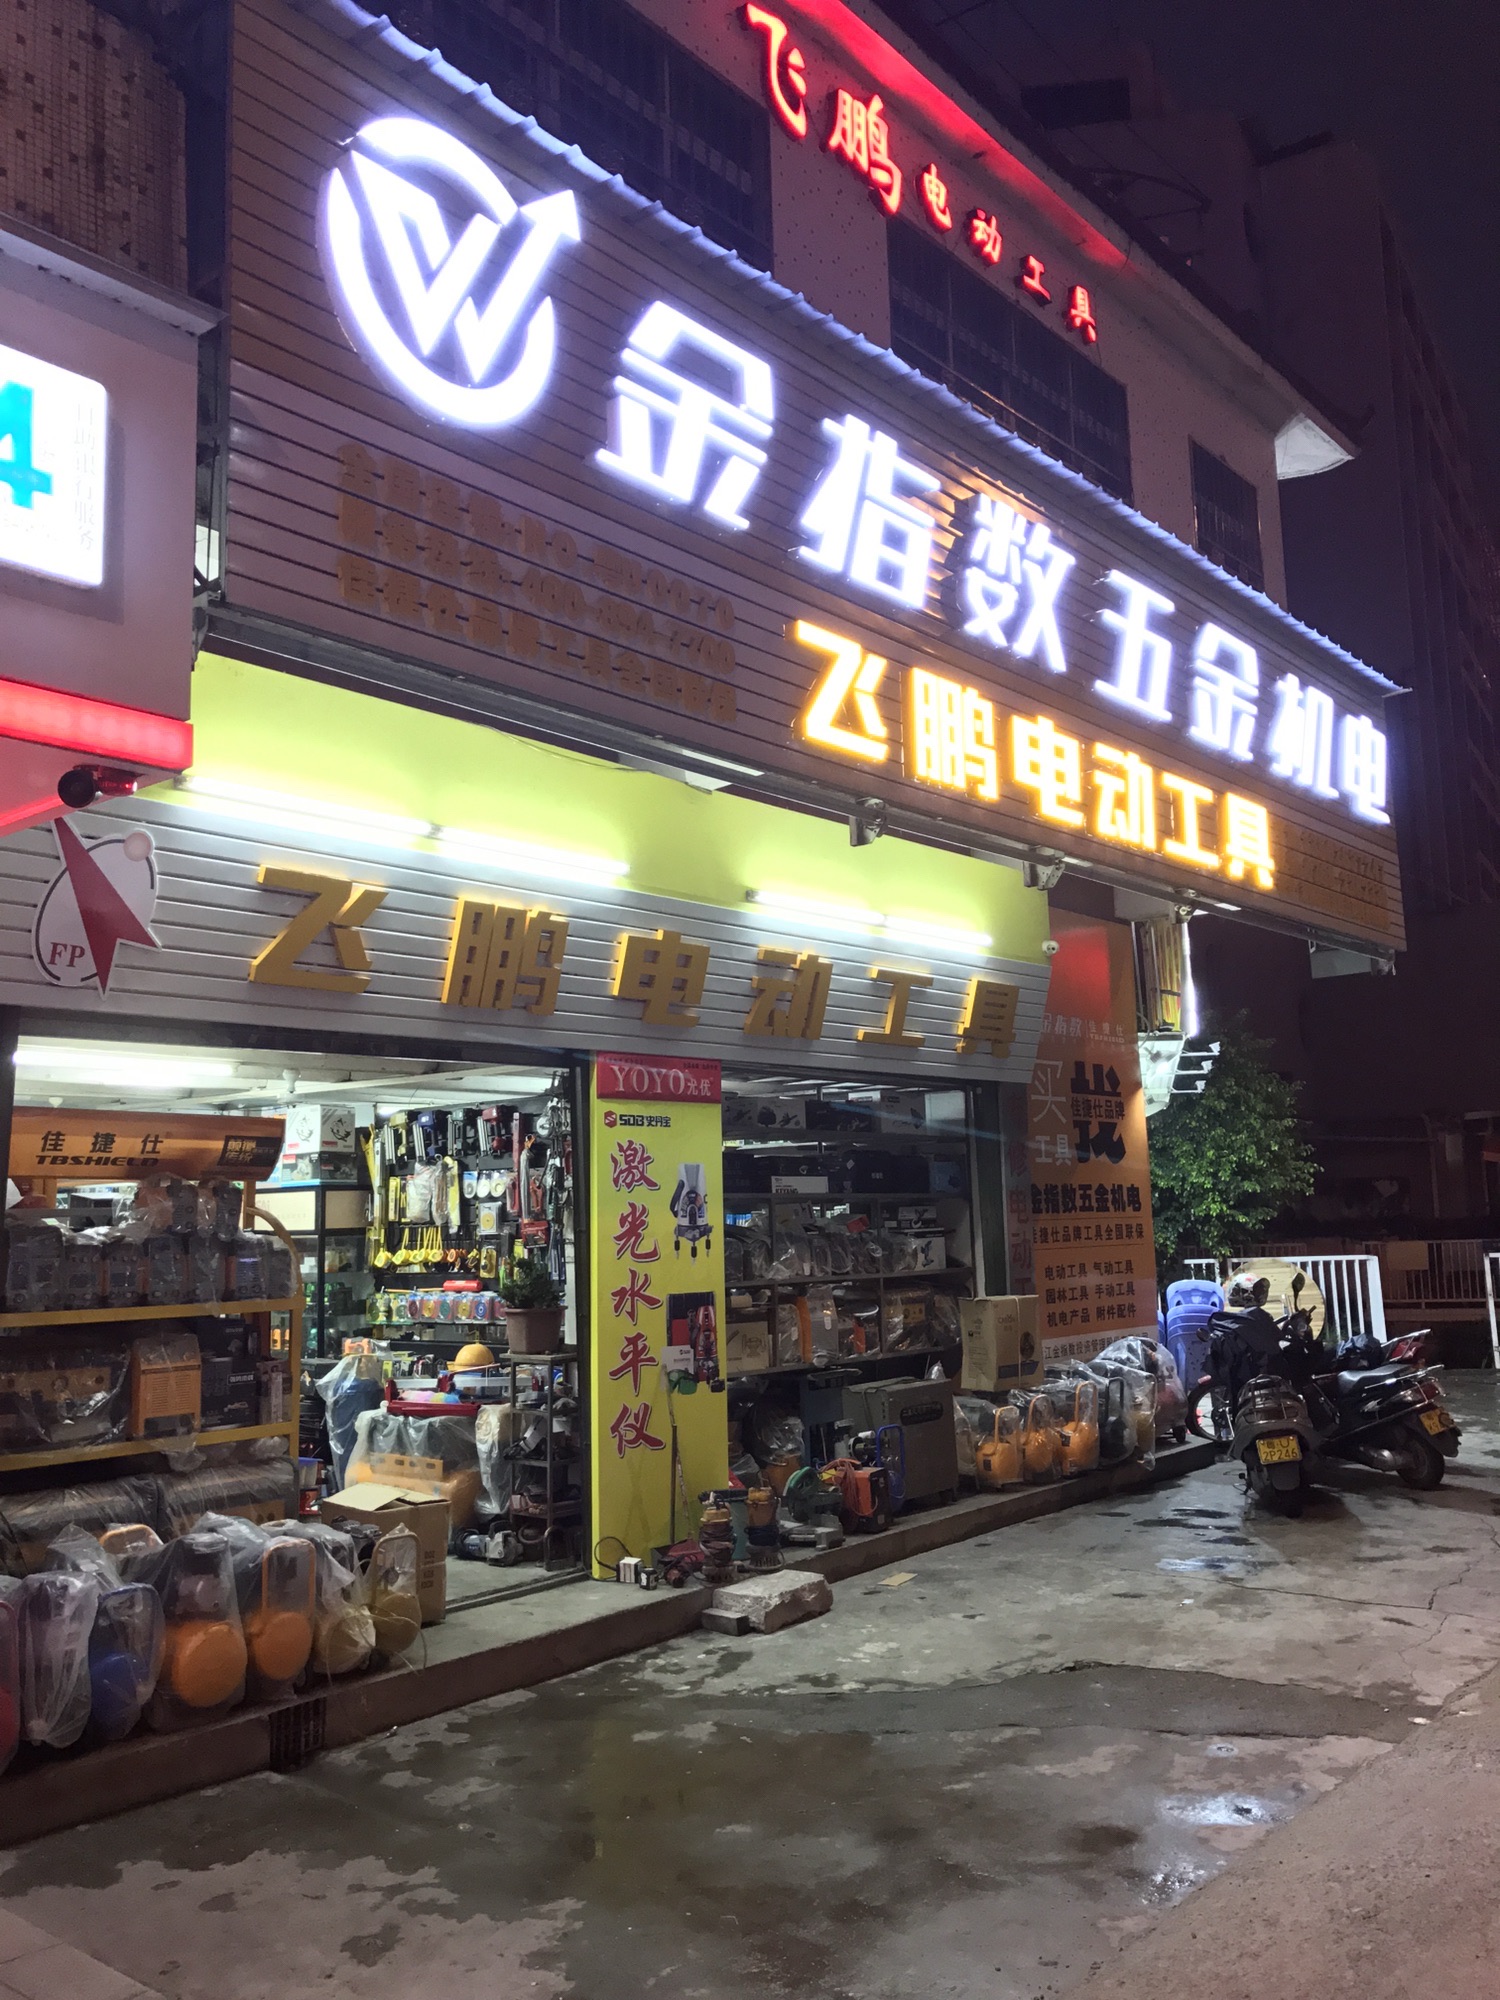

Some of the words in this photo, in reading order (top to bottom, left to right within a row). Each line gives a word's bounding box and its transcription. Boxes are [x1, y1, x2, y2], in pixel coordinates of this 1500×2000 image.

[741, 4, 1098, 345] 飞鹏电动工具
[595, 300, 1391, 826] 金指数五金机电
[793, 619, 1277, 890] 飞鹏电动工具
[47, 941, 86, 968] FP
[248, 864, 1021, 1059] 飞鹏电动工具
[610, 1064, 686, 1095] YOYO
[40, 1130, 165, 1154] 佳捷仕
[1035, 1134, 1072, 1167] 工具
[36, 1155, 160, 1168] TBSHIELD
[1045, 1262, 1088, 1281] 电动工具
[1093, 1259, 1134, 1276] 气动工具
[608, 1139, 667, 1459] 激光水平仪
[1046, 1285, 1089, 1305] 园林工具
[1095, 1281, 1136, 1299] 手动工具
[1047, 1307, 1090, 1328] 机电产品
[1096, 1303, 1137, 1320] 附件配件
[1263, 1448, 1298, 1462] 2P246
